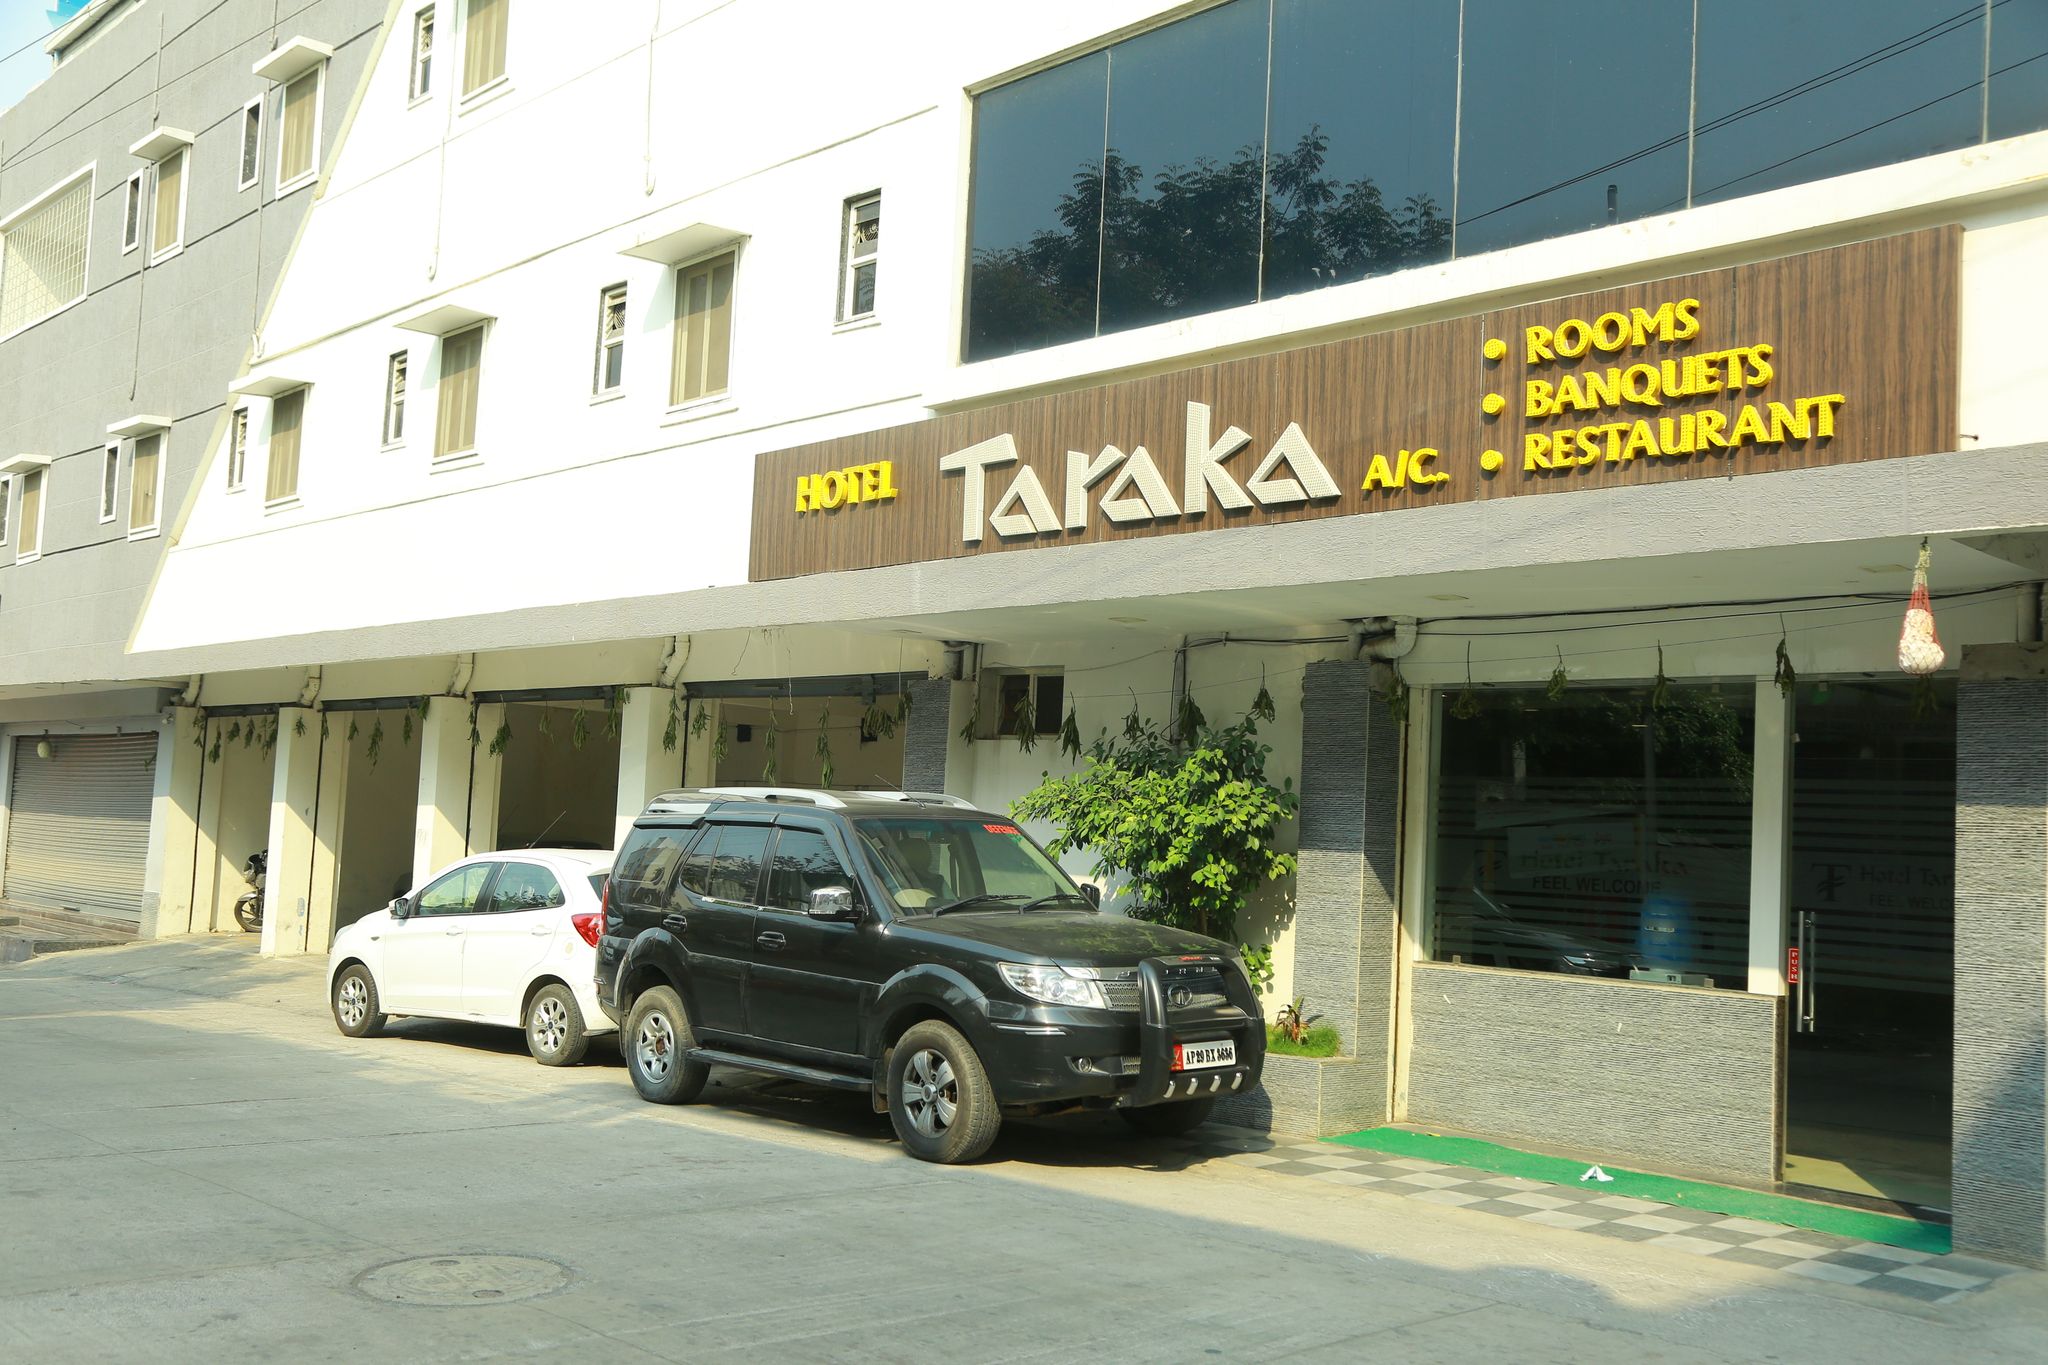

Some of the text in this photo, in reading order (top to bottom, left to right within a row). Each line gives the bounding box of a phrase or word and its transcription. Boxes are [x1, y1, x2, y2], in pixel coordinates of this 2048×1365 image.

[1526, 298, 1700, 365] ROOMS
[1525, 343, 1774, 418] BANQUETS
[1523, 393, 1845, 472] RESTAURANT
[795, 460, 899, 513] HOTEL
[1532, 876, 1571, 891] FEEL
[1790, 951, 1798, 980] PUSH
